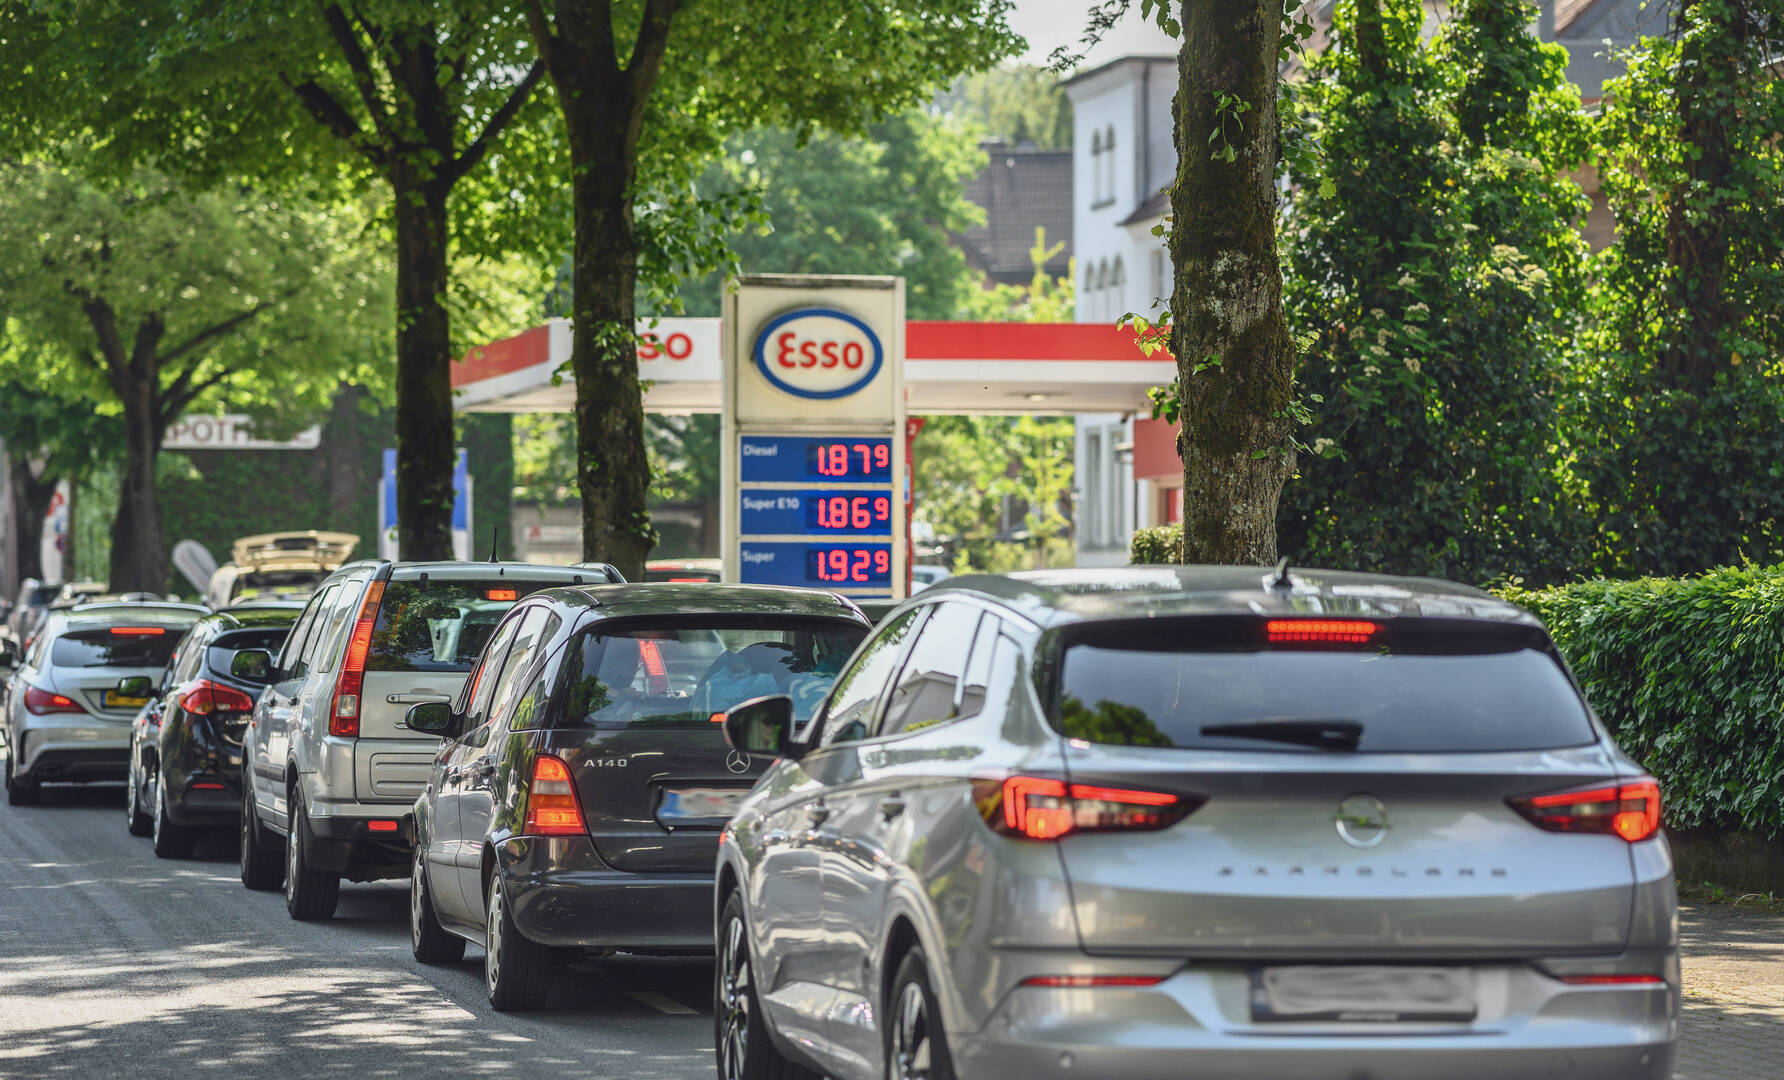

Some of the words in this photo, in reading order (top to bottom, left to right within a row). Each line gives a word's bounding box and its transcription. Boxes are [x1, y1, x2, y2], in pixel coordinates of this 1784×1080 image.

[636, 333, 693, 361] so
[777, 332, 864, 370] Esso
[742, 444, 778, 456] Diesel
[817, 444, 889, 476] 1.879
[742, 497, 775, 512] Super
[777, 497, 799, 510] E10
[817, 497, 890, 529] 1.869
[742, 550, 775, 565] Super
[817, 549, 890, 582] 1.929
[583, 758, 628, 768] A140
